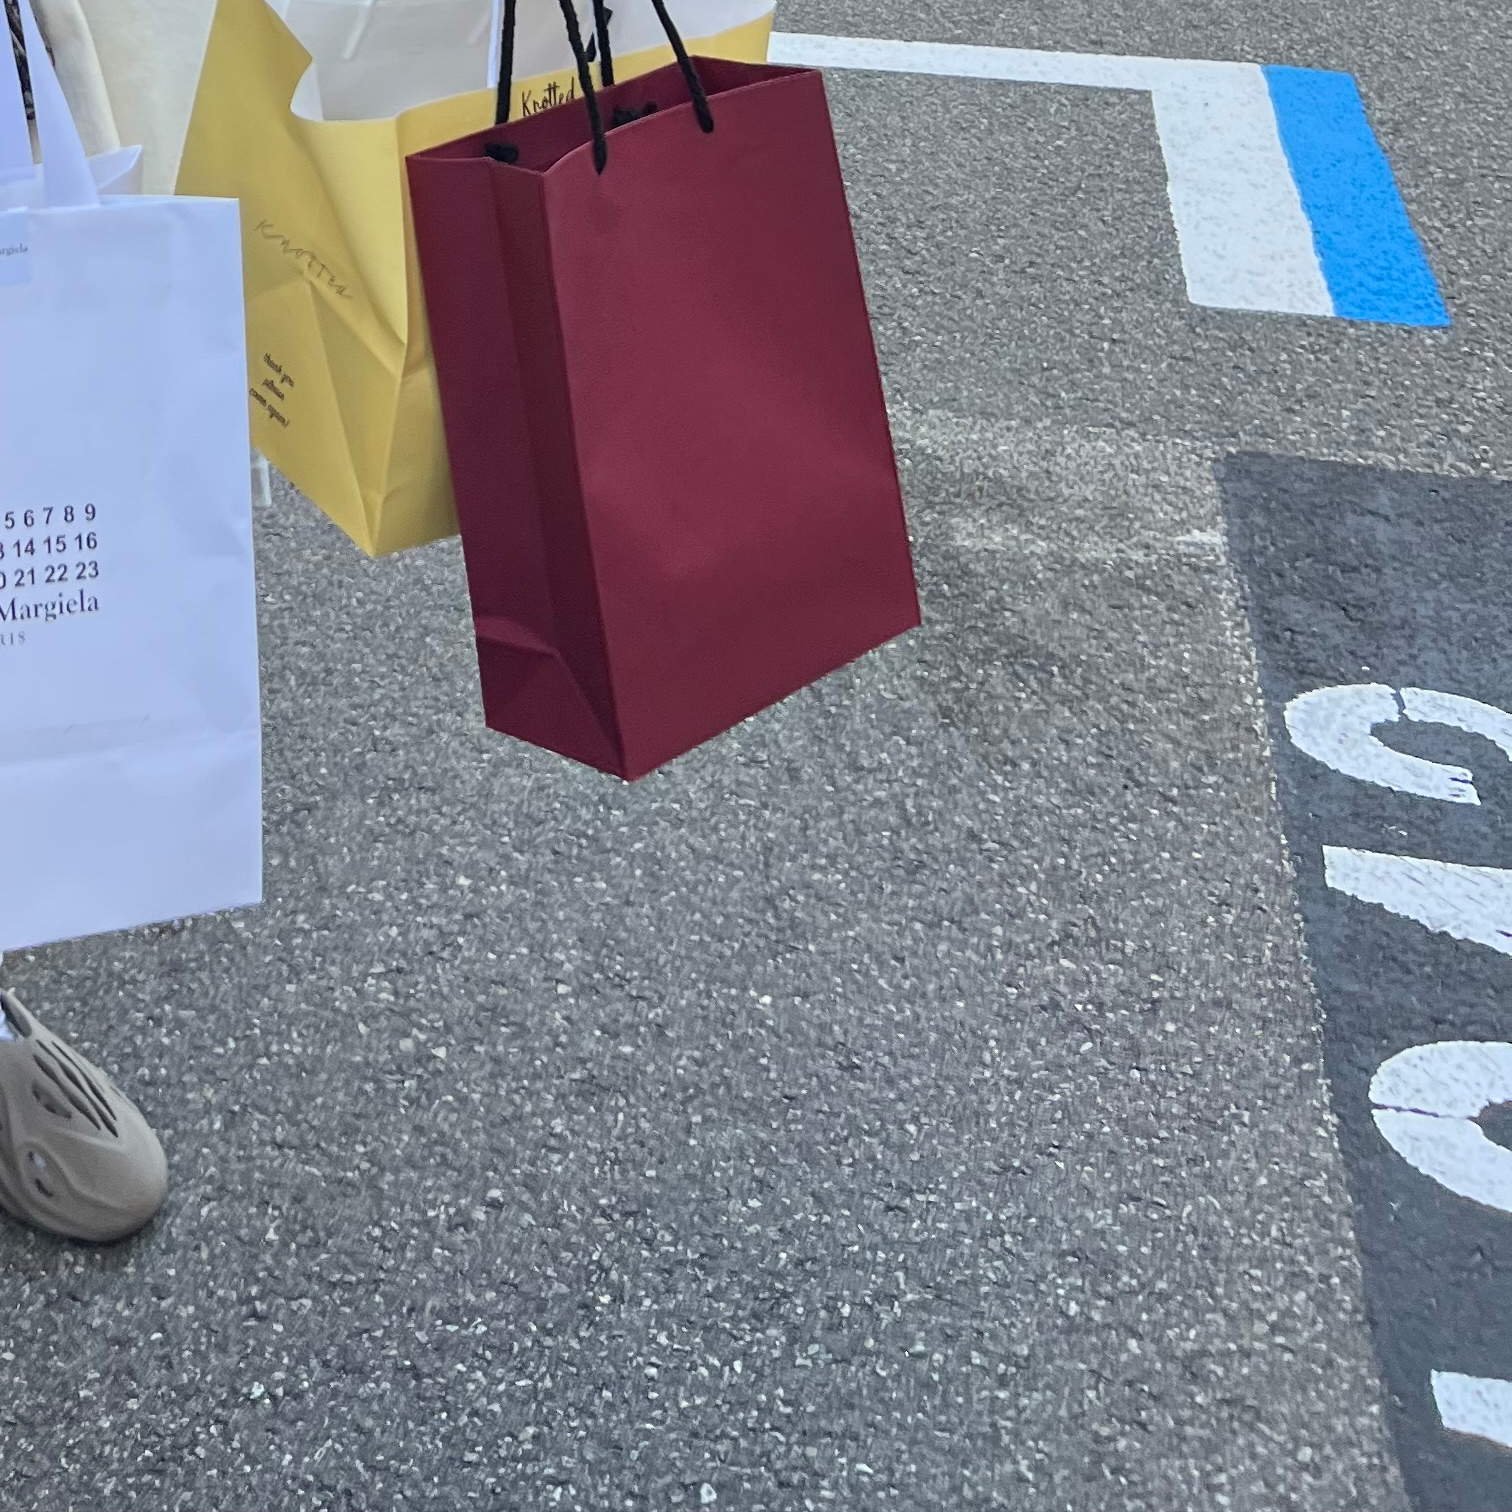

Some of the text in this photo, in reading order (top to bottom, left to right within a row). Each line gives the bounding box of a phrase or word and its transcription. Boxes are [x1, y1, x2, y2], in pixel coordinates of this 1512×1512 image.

[4, 511, 16, 529] 5
[23, 509, 35, 527] 6
[42, 506, 54, 525] 7
[63, 504, 75, 523] 8
[84, 503, 97, 521] 9
[13, 537, 36, 558] 14
[43, 534, 67, 554] 15
[74, 531, 98, 551] 16
[14, 566, 36, 587] 21
[44, 563, 69, 584] 22
[75, 560, 100, 580] 23
